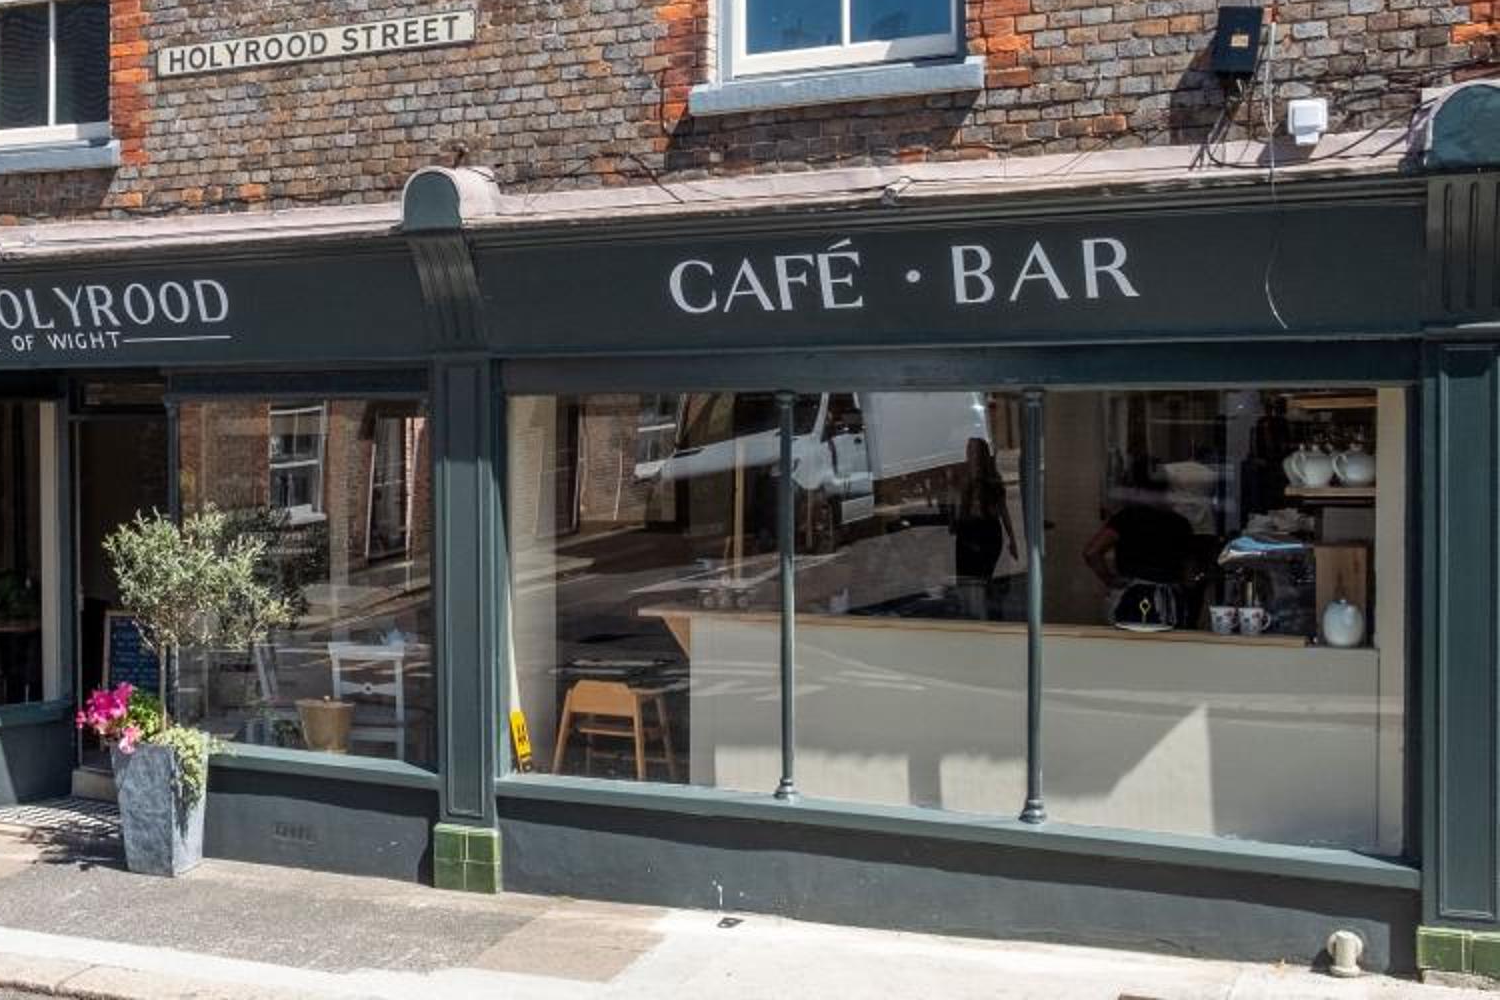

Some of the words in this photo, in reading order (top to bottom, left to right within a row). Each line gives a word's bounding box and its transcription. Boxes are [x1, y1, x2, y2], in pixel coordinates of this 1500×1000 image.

[168, 31, 328, 73] HOLYROOD
[341, 15, 460, 52] STREET
[669, 237, 864, 313] CAFÉ
[950, 237, 1141, 304] BAR
[11, 334, 35, 352] OF
[47, 331, 122, 351] WIGHT
